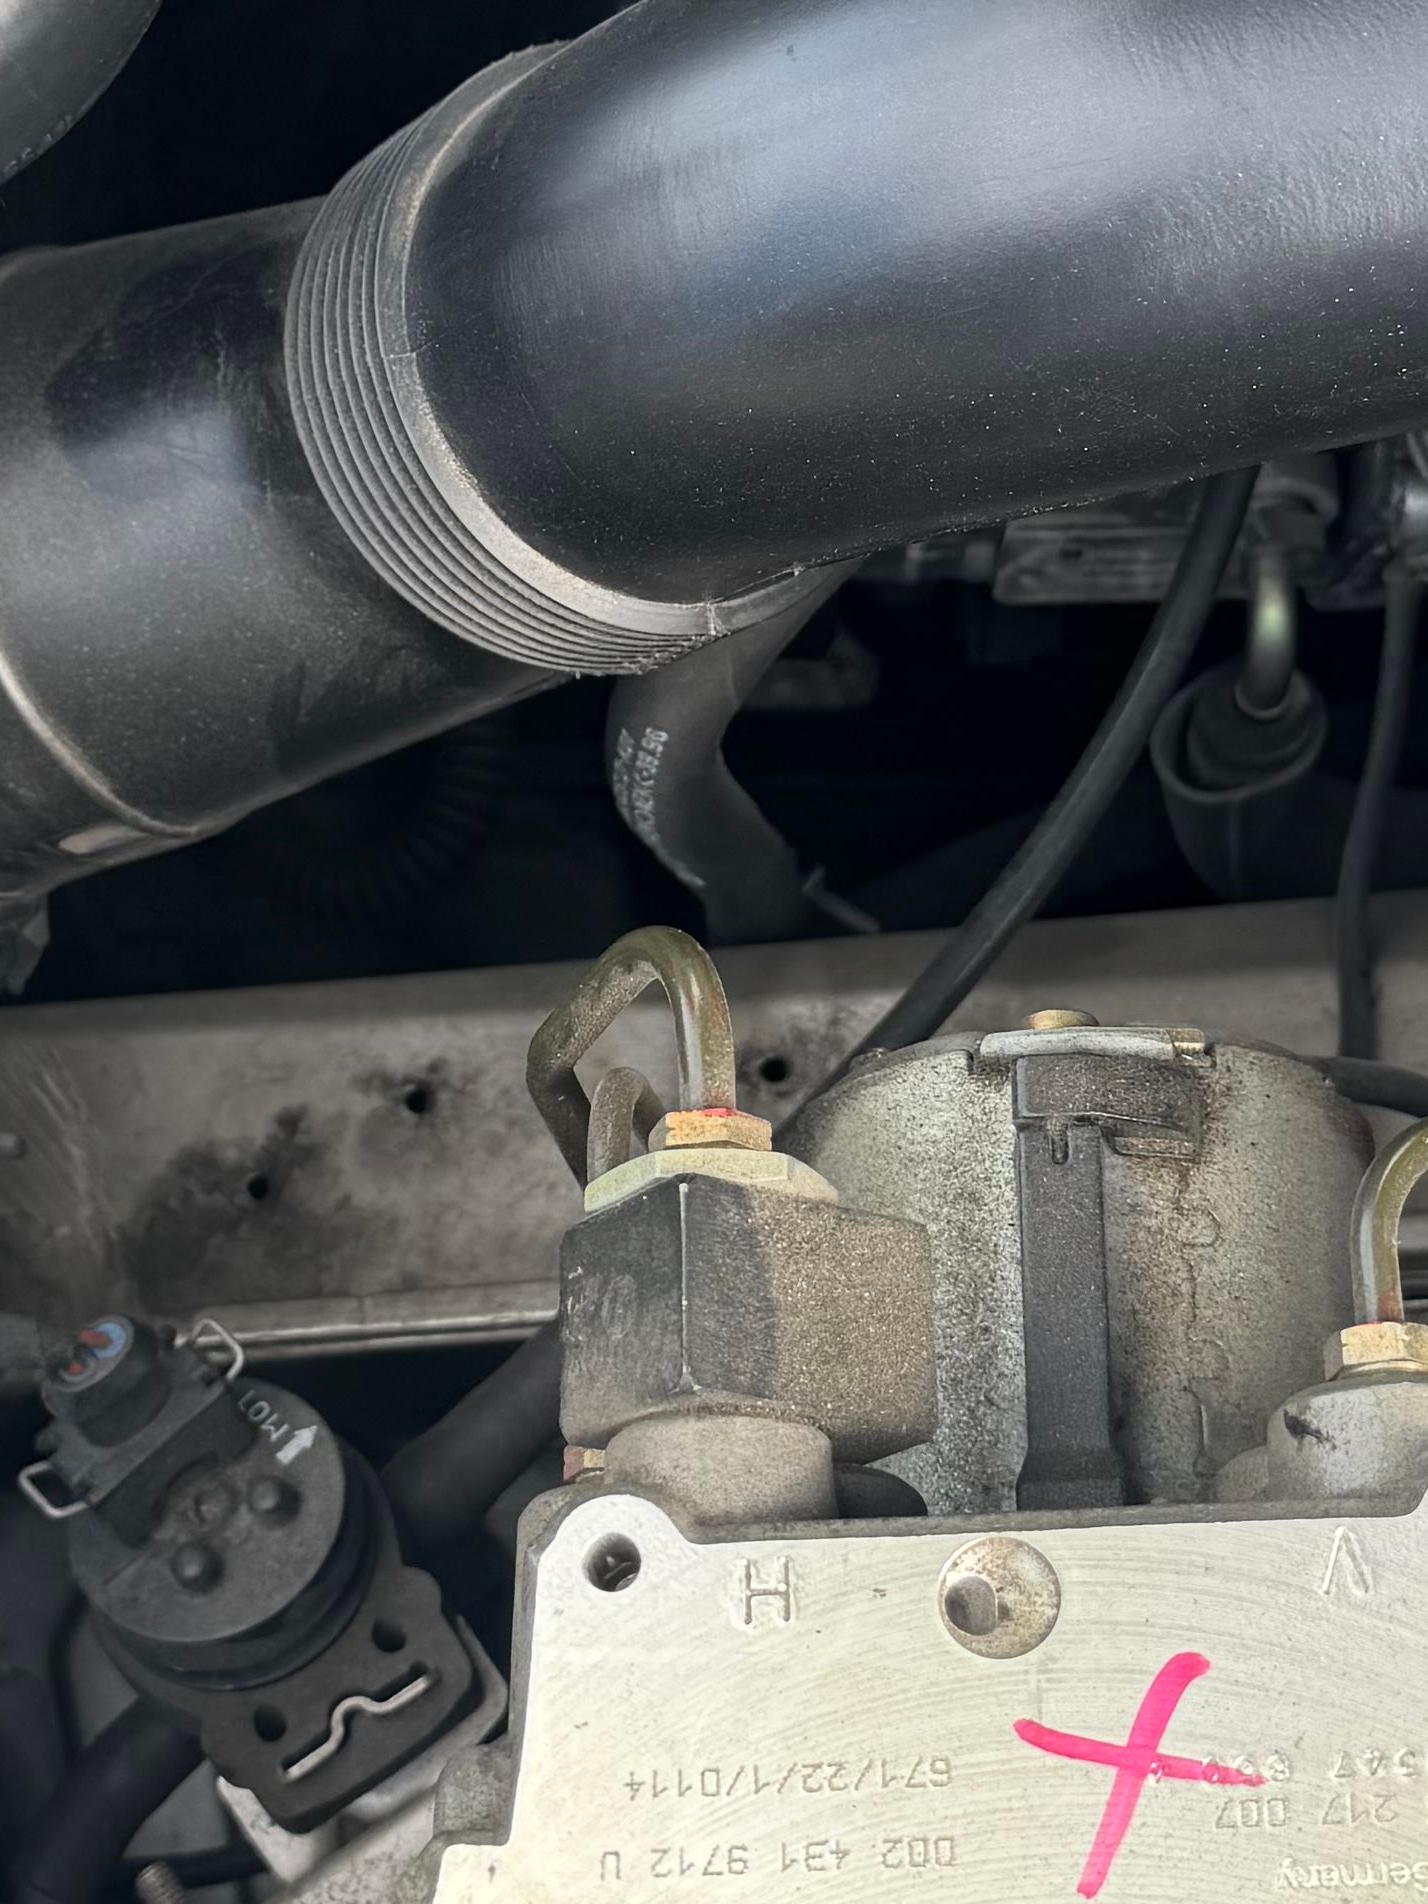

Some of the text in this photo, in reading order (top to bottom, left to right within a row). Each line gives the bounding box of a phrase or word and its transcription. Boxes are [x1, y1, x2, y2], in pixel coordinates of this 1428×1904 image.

[1322, 1525, 1372, 1599] V
[735, 1557, 794, 1627] H
[623, 1755, 954, 1801] 671/22/1/0114
[1214, 1796, 1288, 1829] 007
[1321, 1792, 1400, 1826] 217
[599, 1836, 956, 1881] 002 431 9712 U
